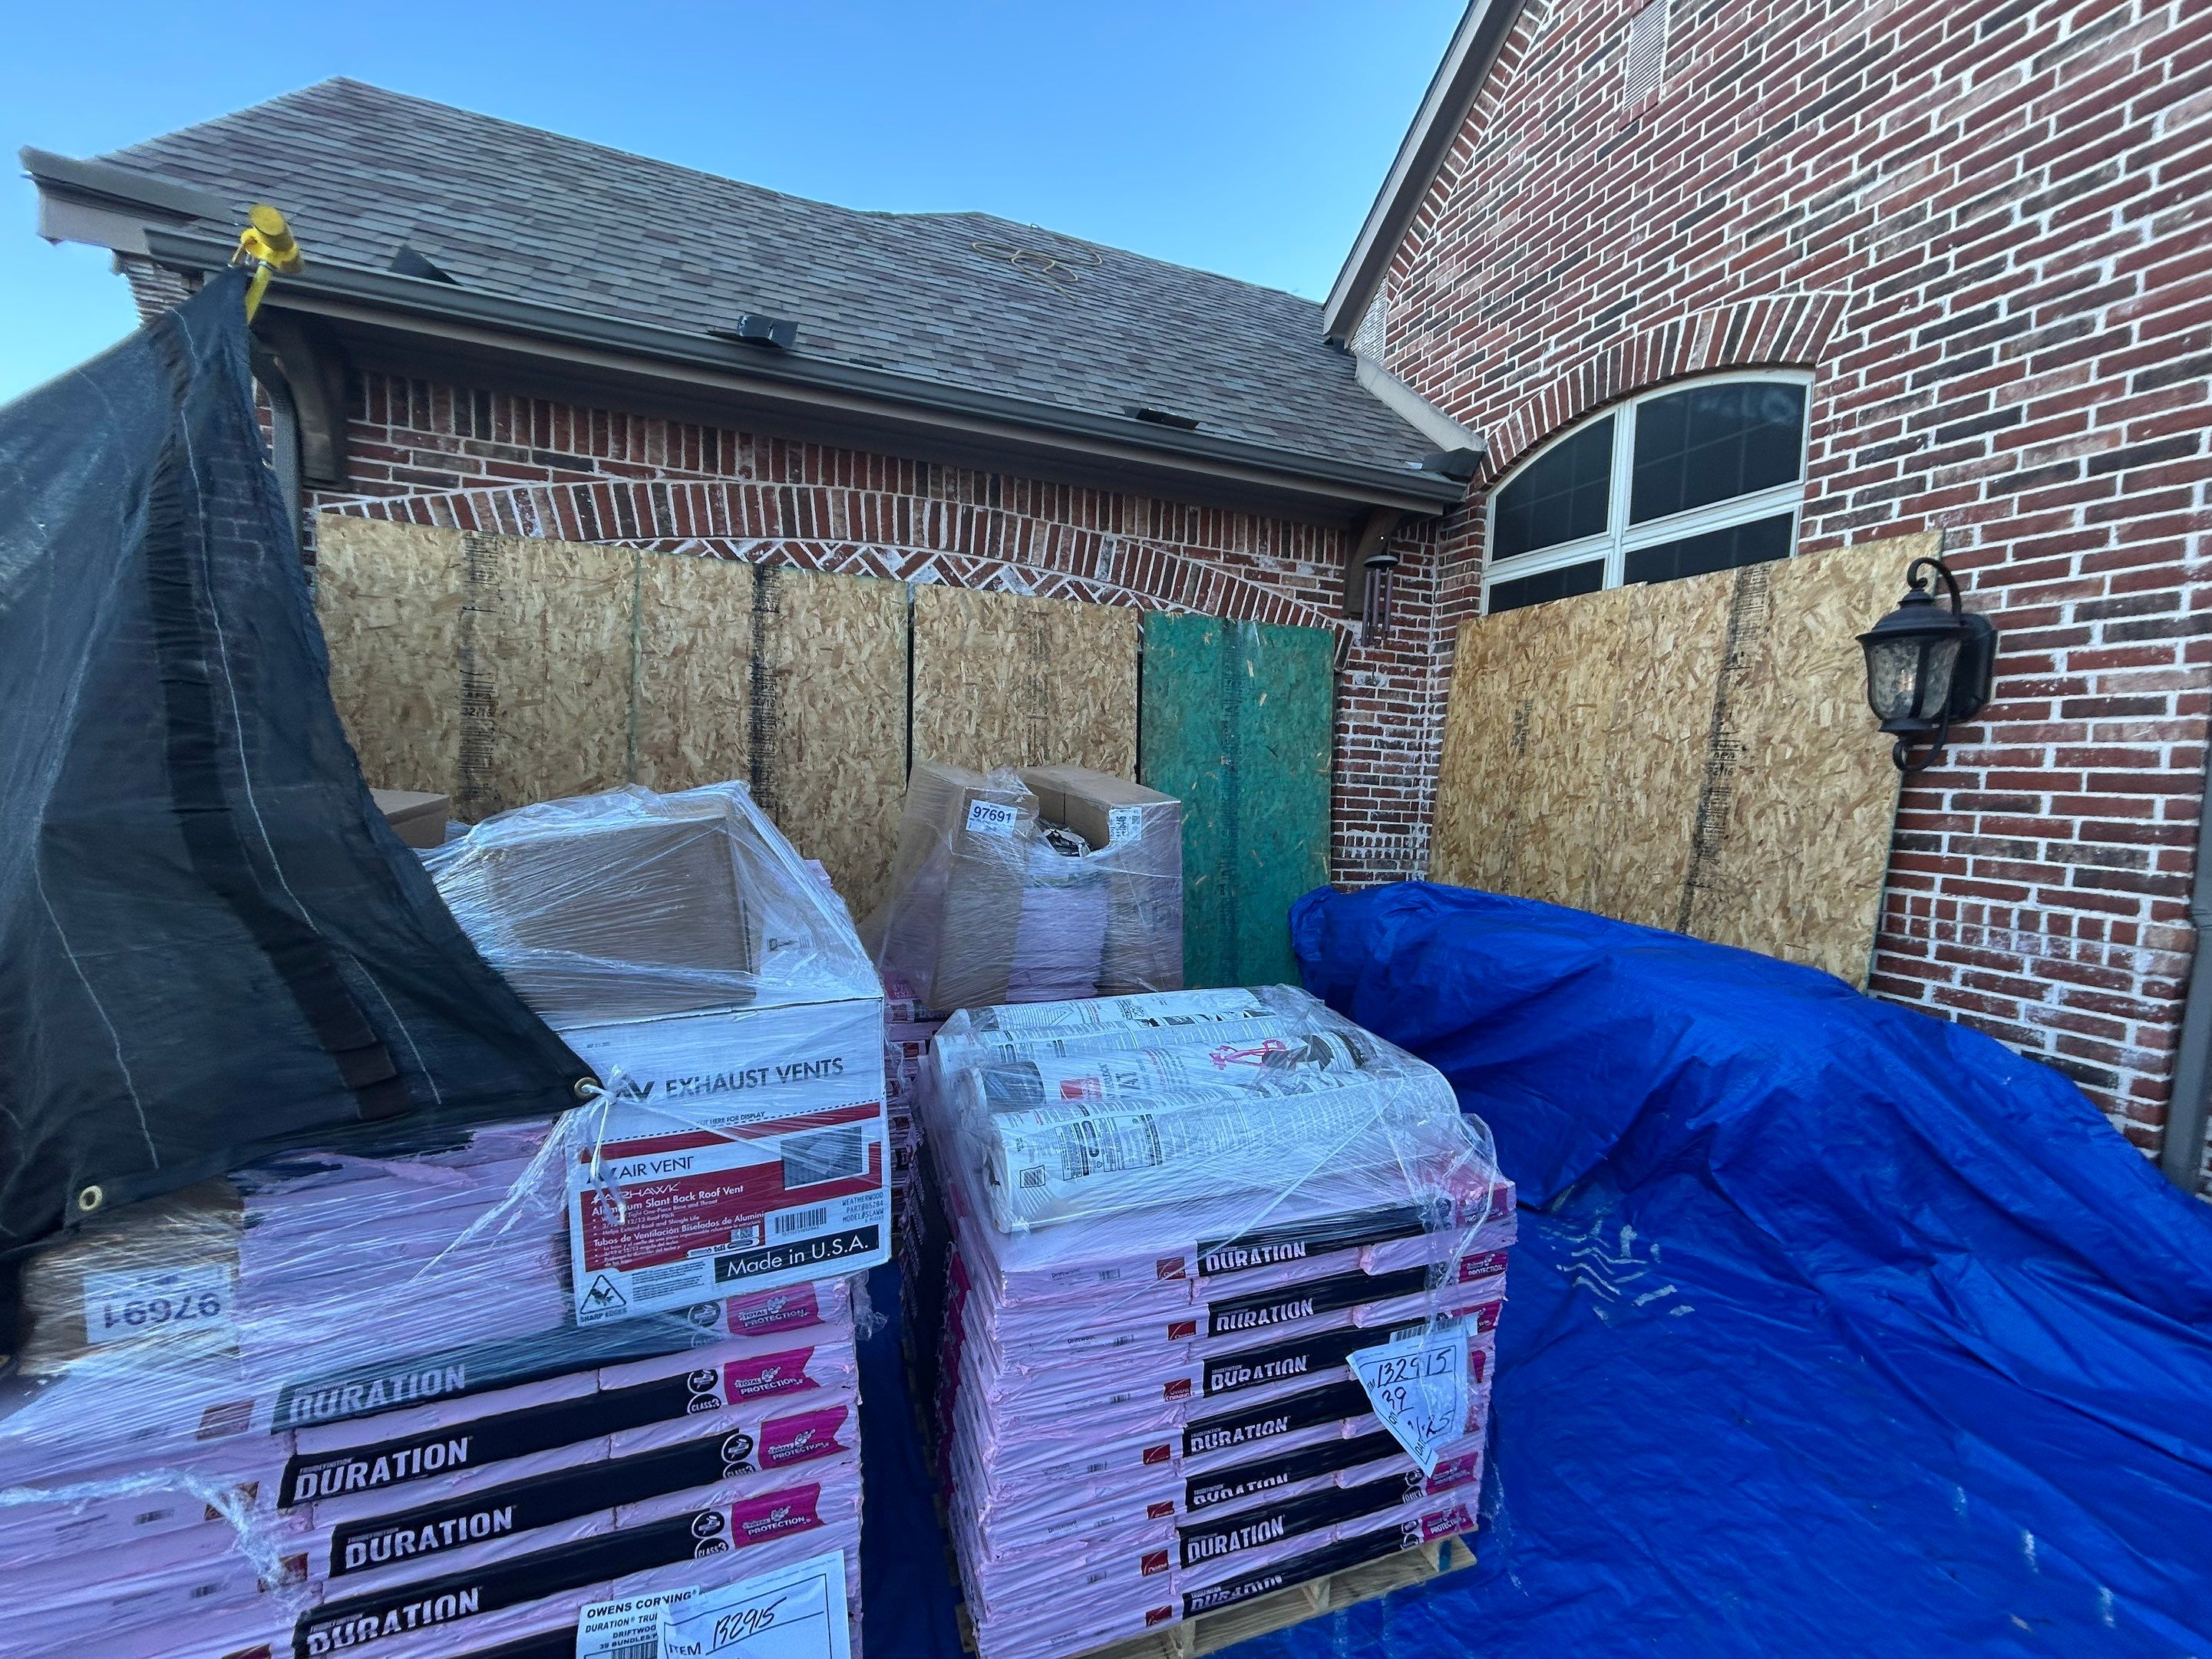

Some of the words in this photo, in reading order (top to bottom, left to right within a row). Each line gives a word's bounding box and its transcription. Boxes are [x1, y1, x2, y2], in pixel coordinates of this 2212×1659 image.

[972, 806, 1012, 824] 97691
[665, 1067, 770, 1099] EXHAUST
[775, 1057, 844, 1084] VENTS
[740, 1111, 765, 1121] DISPLAY
[619, 1163, 646, 1179] AIR
[650, 1156, 694, 1174] VENT
[645, 1197, 670, 1209] Slant
[672, 1192, 696, 1205] Back
[698, 1187, 721, 1199] Roof
[723, 1185, 744, 1196] Vent
[841, 1192, 884, 1206] WEATHERWOOD
[593, 1238, 619, 1247] Tubos
[620, 1234, 632, 1242] de
[634, 1228, 679, 1240] Ventilación
[682, 1219, 720, 1233] Biselados
[721, 1217, 732, 1225] de
[726, 1251, 783, 1278] Made
[789, 1248, 804, 1265] in
[812, 1235, 869, 1259] U.S.A.
[1206, 1241, 1306, 1272] DURATION
[104, 1292, 222, 1329] 97691
[744, 1308, 805, 1328] PROTECTION
[1216, 1298, 1314, 1331] DURATION
[741, 1377, 797, 1396] PROTECTION
[1211, 1355, 1307, 1391] DURATION
[289, 1363, 466, 1423] DURATION
[1382, 1386, 1407, 1413] 39
[1190, 1417, 1288, 1453] DURATION
[772, 1441, 824, 1460] PROTECTION
[293, 1436, 469, 1502] DURATION
[345, 1504, 514, 1569] DURATION
[748, 1516, 806, 1536] PROTECTION
[1187, 1515, 1284, 1564] DURATION
[305, 1586, 480, 1656] DURATION
[586, 1601, 632, 1618] OWENS
[599, 1642, 609, 1651] 39
[669, 1641, 702, 1657] ITEM
